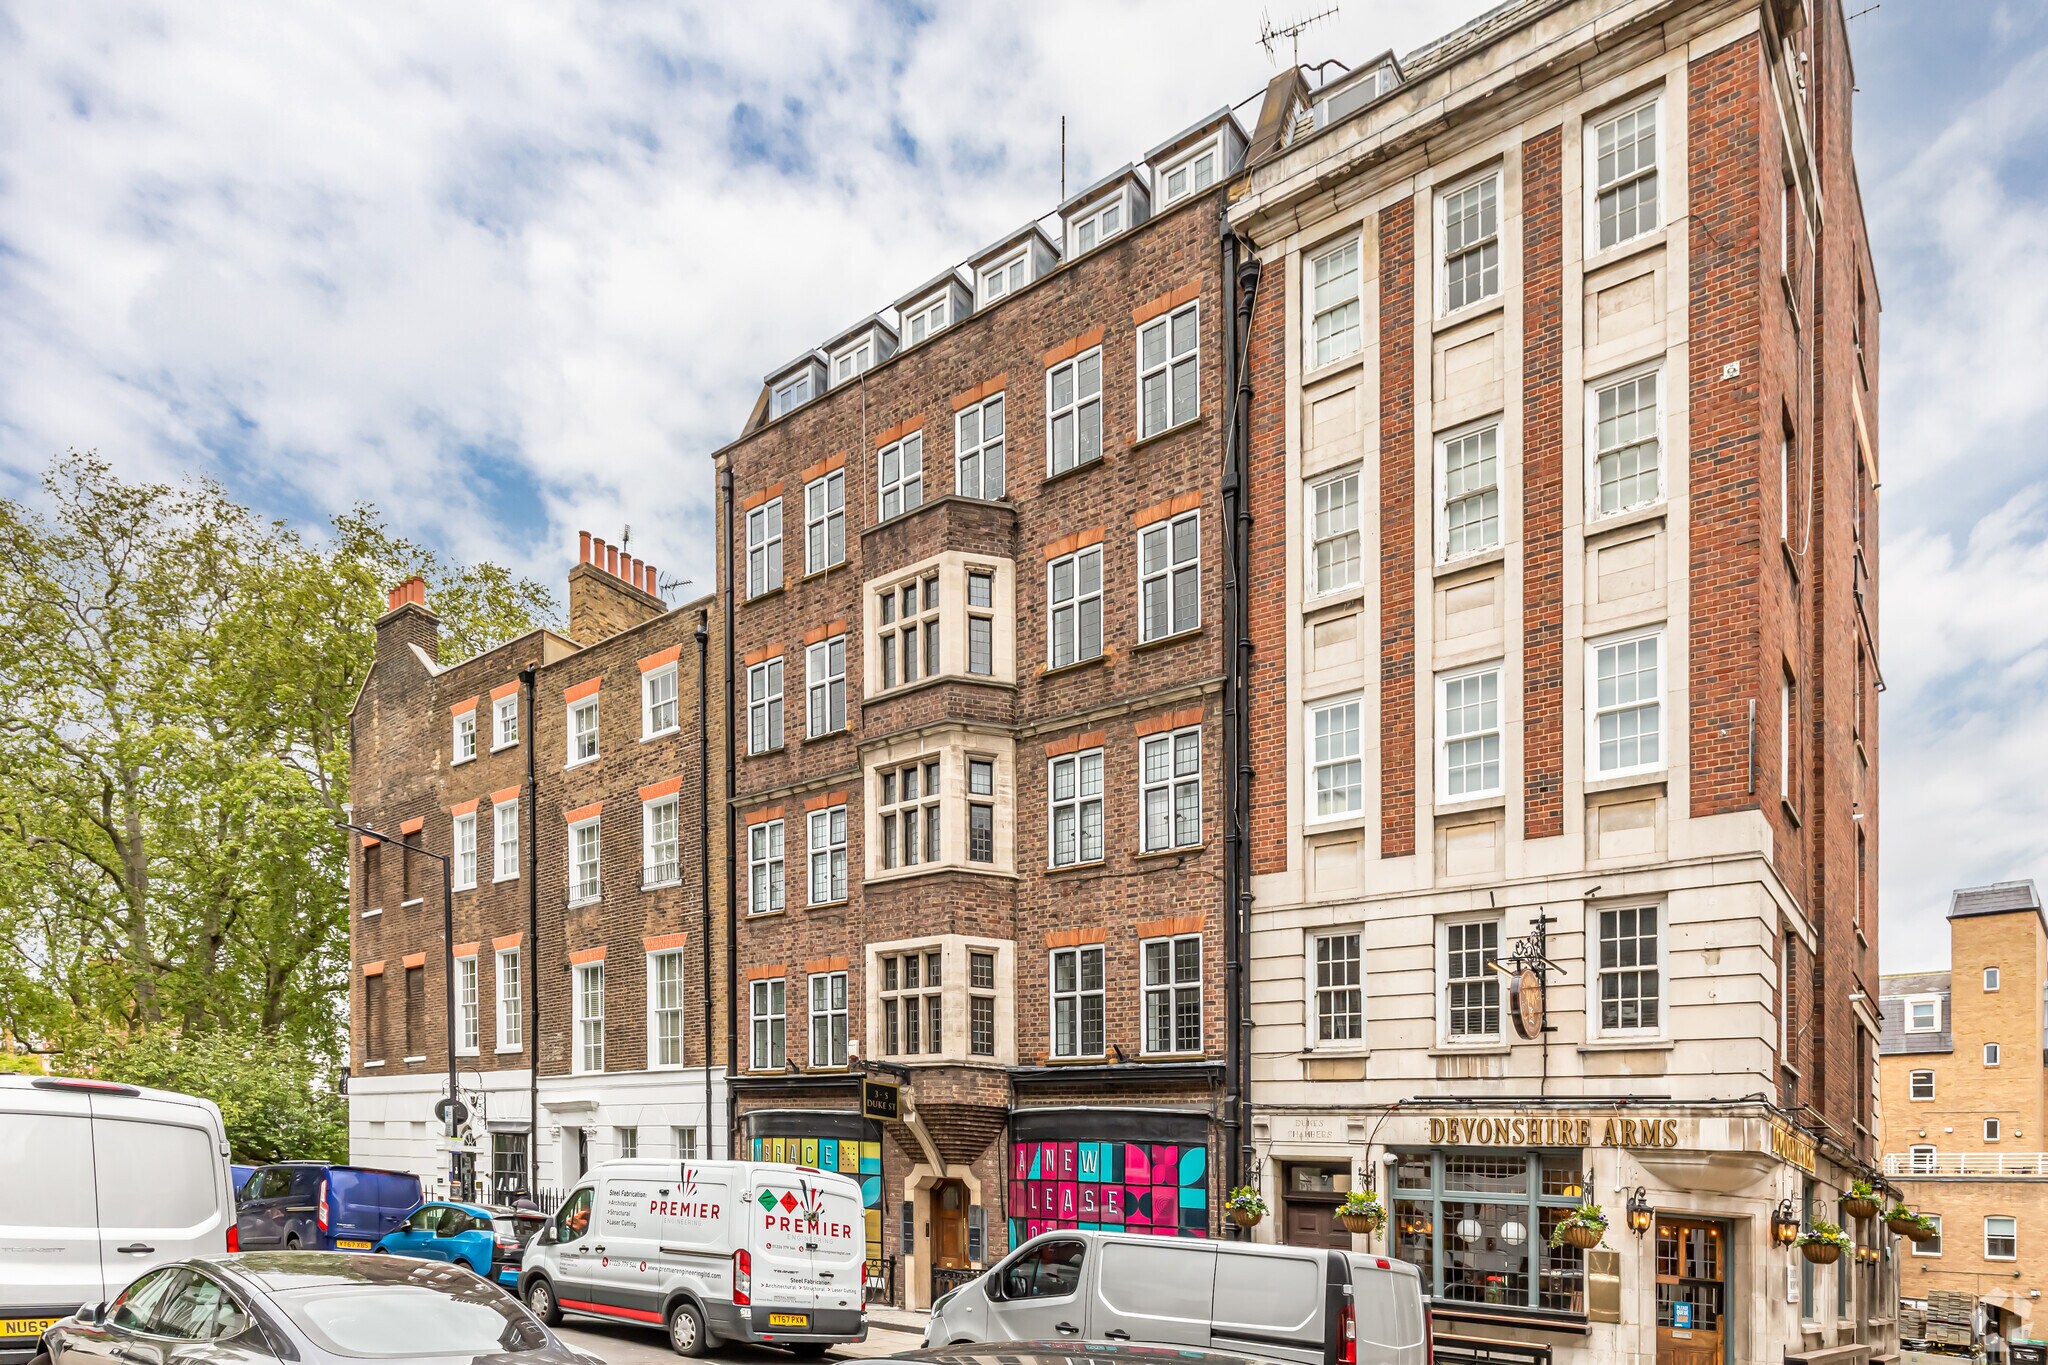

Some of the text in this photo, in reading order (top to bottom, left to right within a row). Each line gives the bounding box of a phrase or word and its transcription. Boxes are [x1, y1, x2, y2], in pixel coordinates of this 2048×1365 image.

[867, 1100, 886, 1110] DUKE
[1287, 1130, 1333, 1139] CHAMBERS
[1429, 1118, 1678, 1147] DEVONSHIRE ARMS
[1019, 1149, 1098, 1173] A NEW
[609, 1189, 621, 1197] Steel
[1031, 1187, 1118, 1215] LEASE
[650, 1200, 720, 1219] PREMIER
[621, 1220, 637, 1228] Cutting
[664, 1218, 702, 1226] ENGINEERING
[765, 1215, 851, 1239] PREMIER
[787, 1234, 834, 1244] ENGINEERING
[772, 1315, 805, 1324] YT67 PXM
[6, 1320, 48, 1334] NU69
